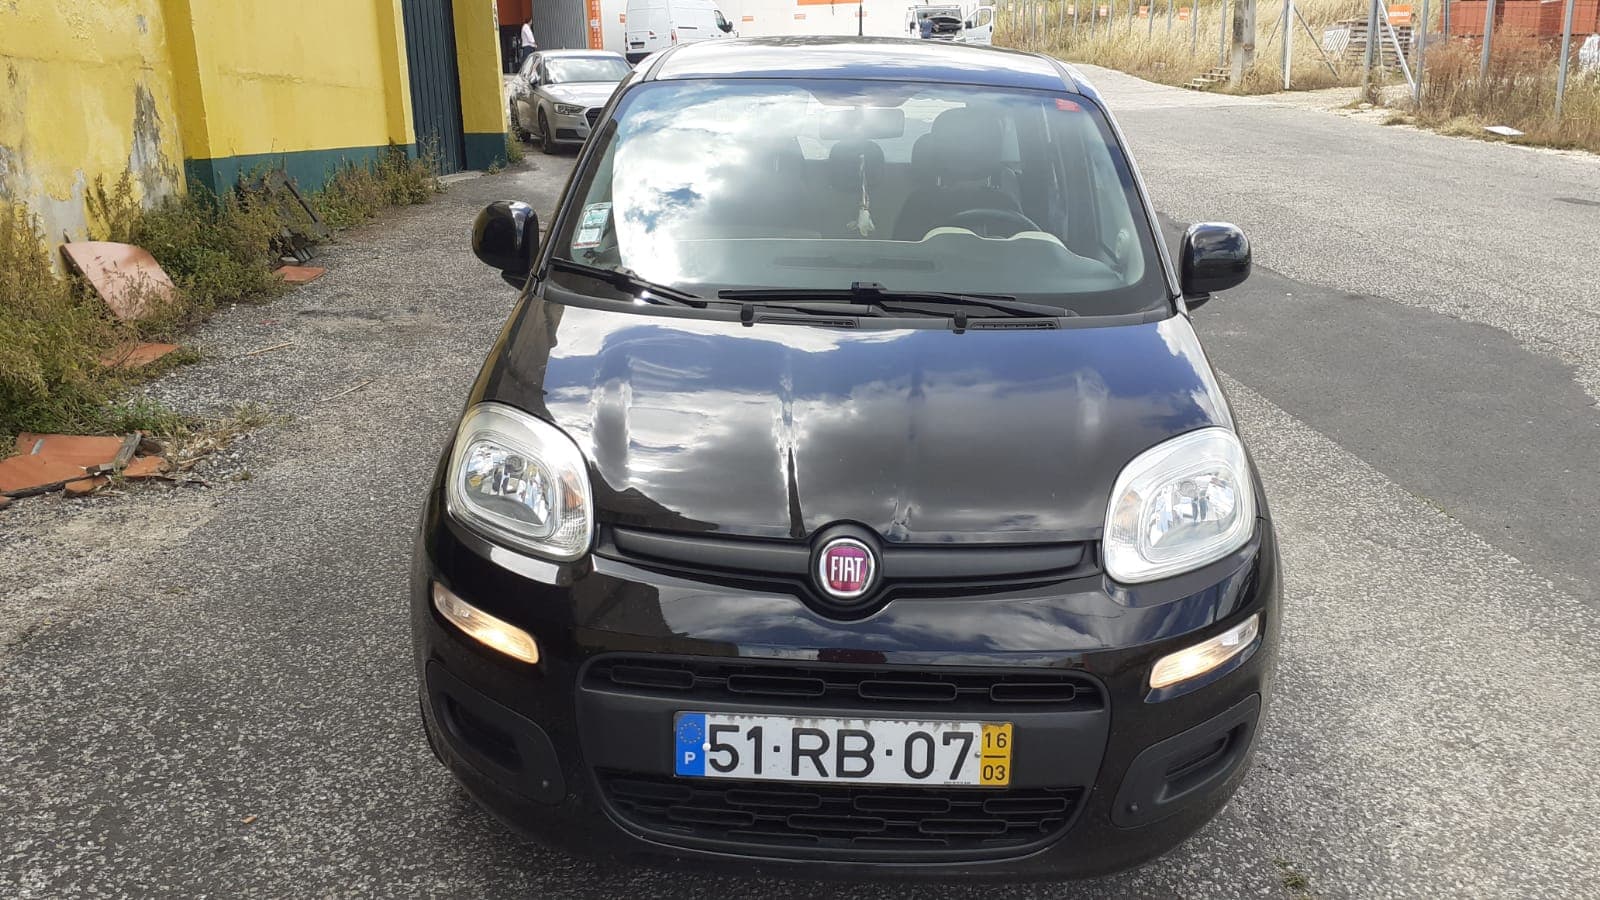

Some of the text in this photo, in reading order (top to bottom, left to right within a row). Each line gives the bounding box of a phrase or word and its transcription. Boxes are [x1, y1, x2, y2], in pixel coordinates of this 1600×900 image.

[831, 555, 864, 583] FIAT
[985, 732, 1008, 749] 16
[684, 751, 696, 765] P
[983, 764, 1006, 781] 03
